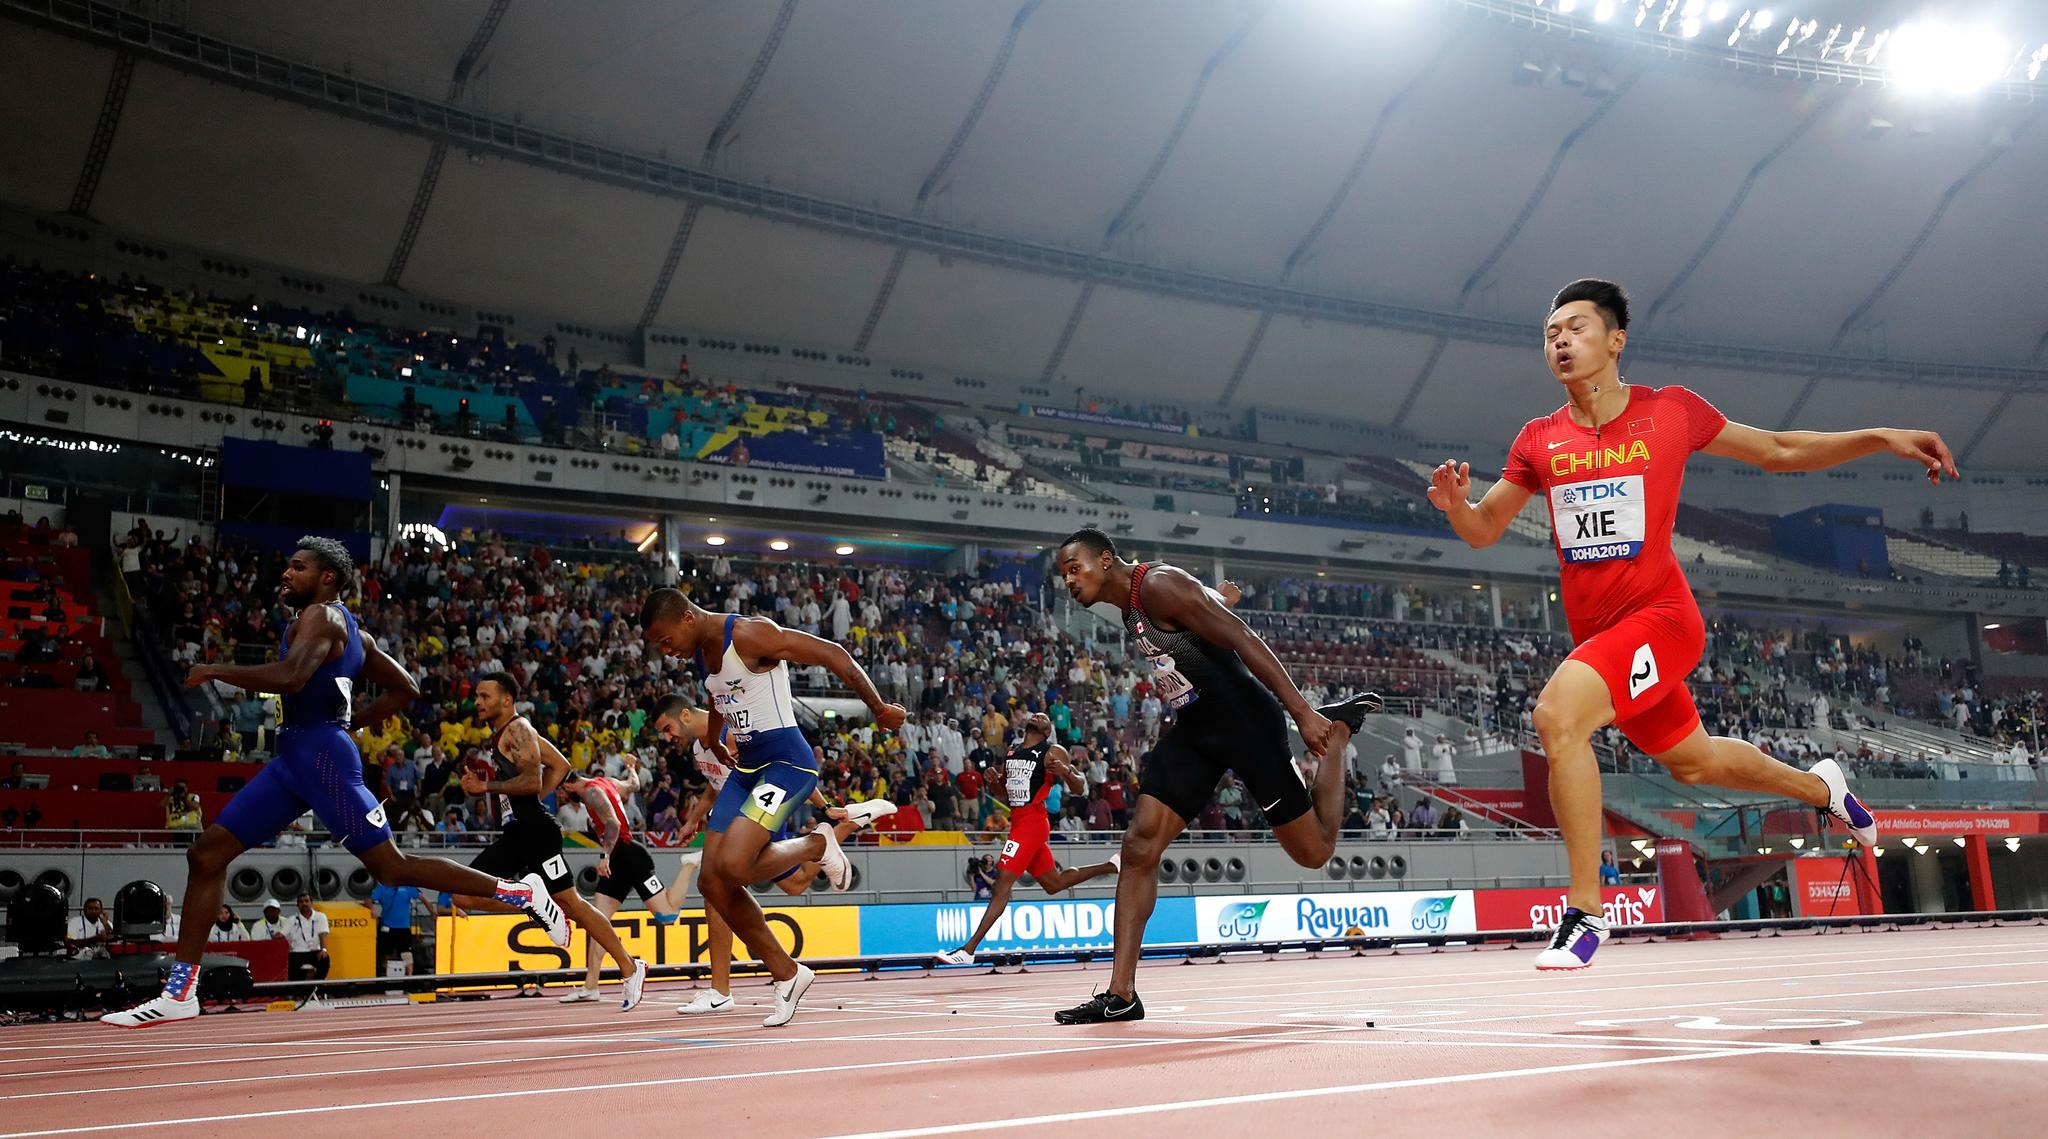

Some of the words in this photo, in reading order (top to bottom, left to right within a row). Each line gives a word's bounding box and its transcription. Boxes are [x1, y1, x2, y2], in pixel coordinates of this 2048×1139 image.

[1551, 440, 1650, 476] CHINA
[1576, 482, 1628, 501] TDK
[1575, 510, 1616, 539] XIE
[1571, 544, 1630, 561] DOHA2019
[1632, 660, 1651, 688] 2
[1006, 759, 1037, 771] TRINIDAD
[759, 791, 776, 808] 4
[1876, 819, 1890, 829] orld
[1892, 819, 1921, 829] Athletics
[1923, 819, 1973, 831] Championships
[1006, 843, 1013, 853] 8
[549, 860, 559, 876] 7
[650, 879, 659, 890] 9
[1297, 897, 1389, 938] Rayyan
